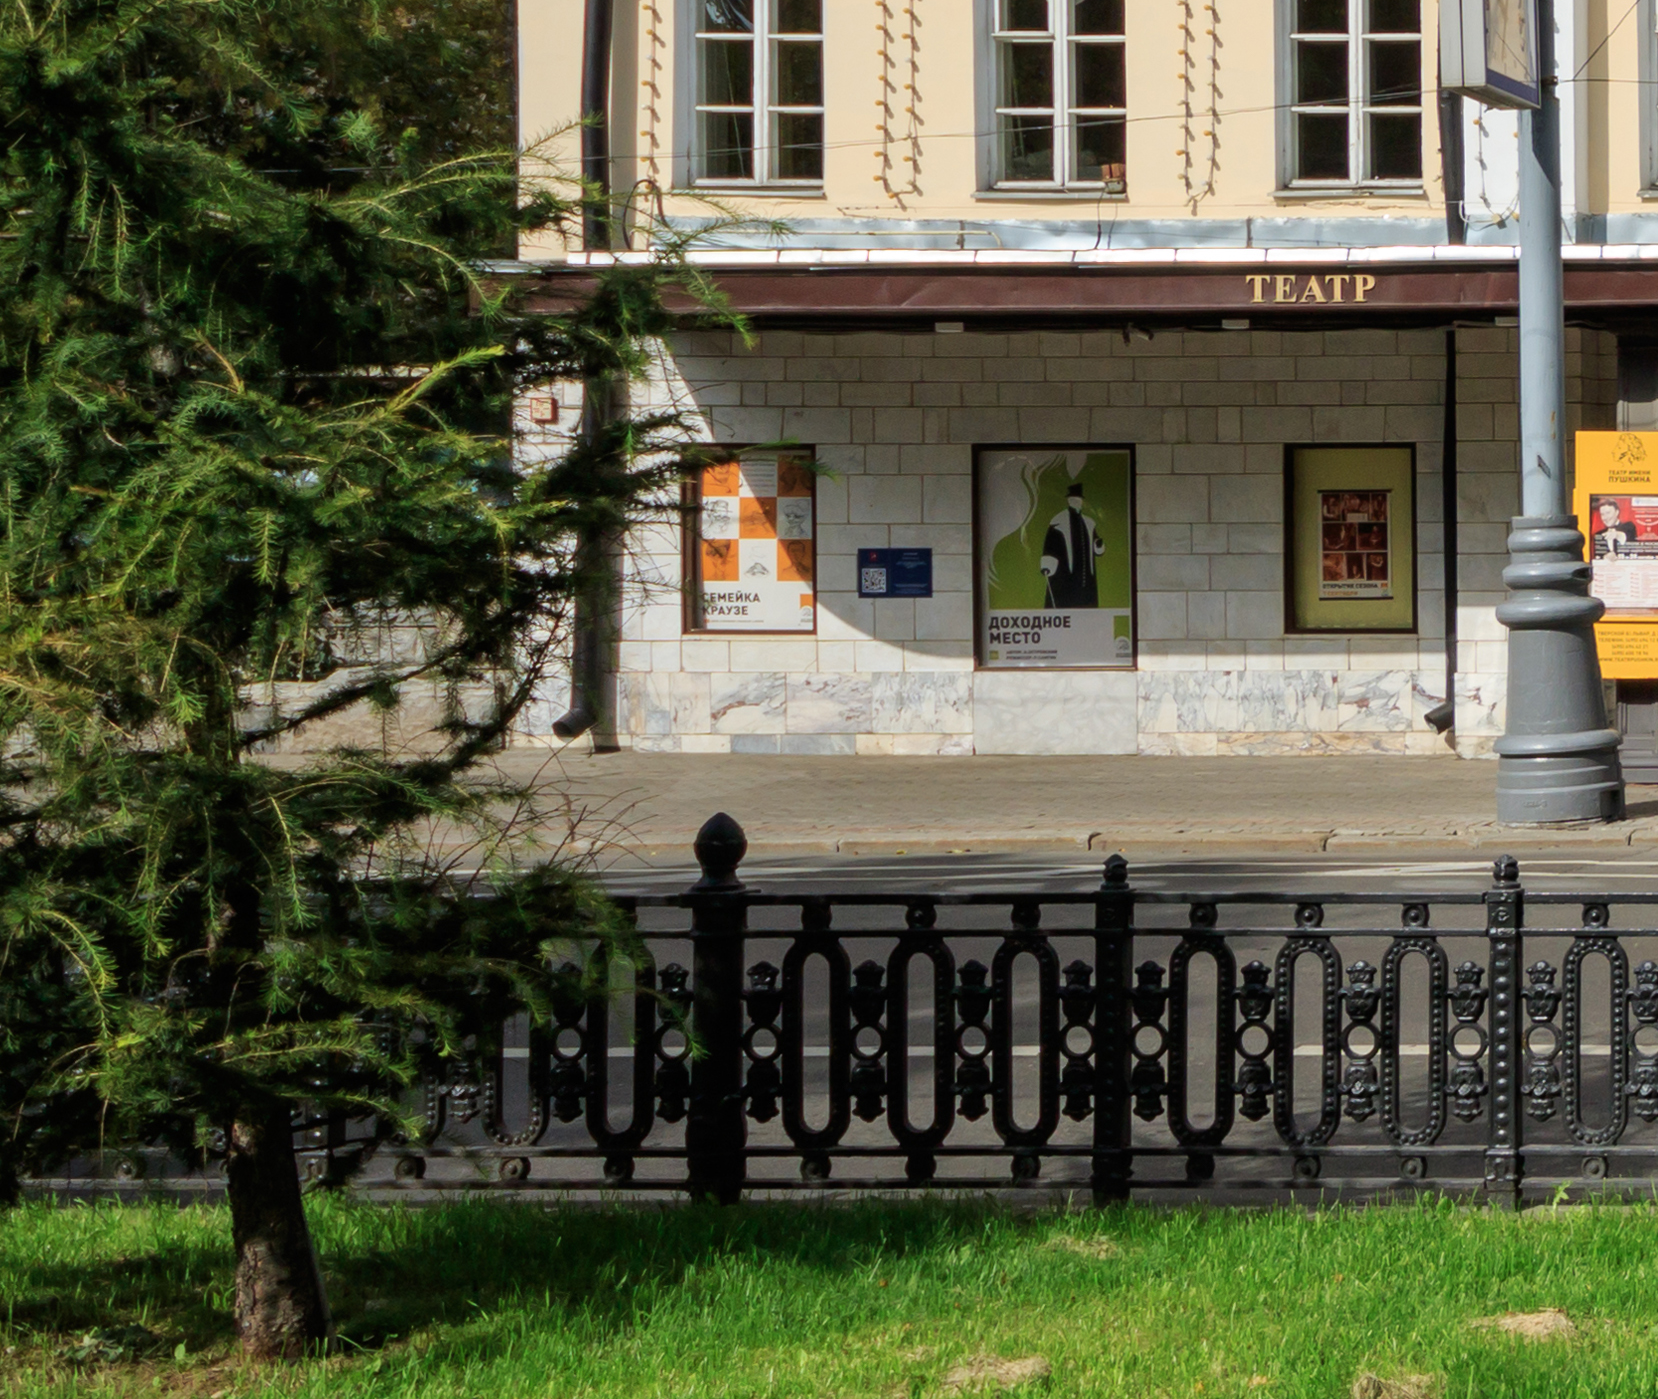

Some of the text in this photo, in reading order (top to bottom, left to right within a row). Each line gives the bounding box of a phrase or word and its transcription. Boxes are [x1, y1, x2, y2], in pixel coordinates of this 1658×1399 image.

[1245, 274, 1376, 303] ТЕАТР
[702, 590, 760, 602] СЕМЕЙКА
[702, 605, 748, 616] КРАУЗЕ
[989, 616, 1071, 631] ДОХОДНОЕ
[989, 632, 1041, 644] МЕСТО
